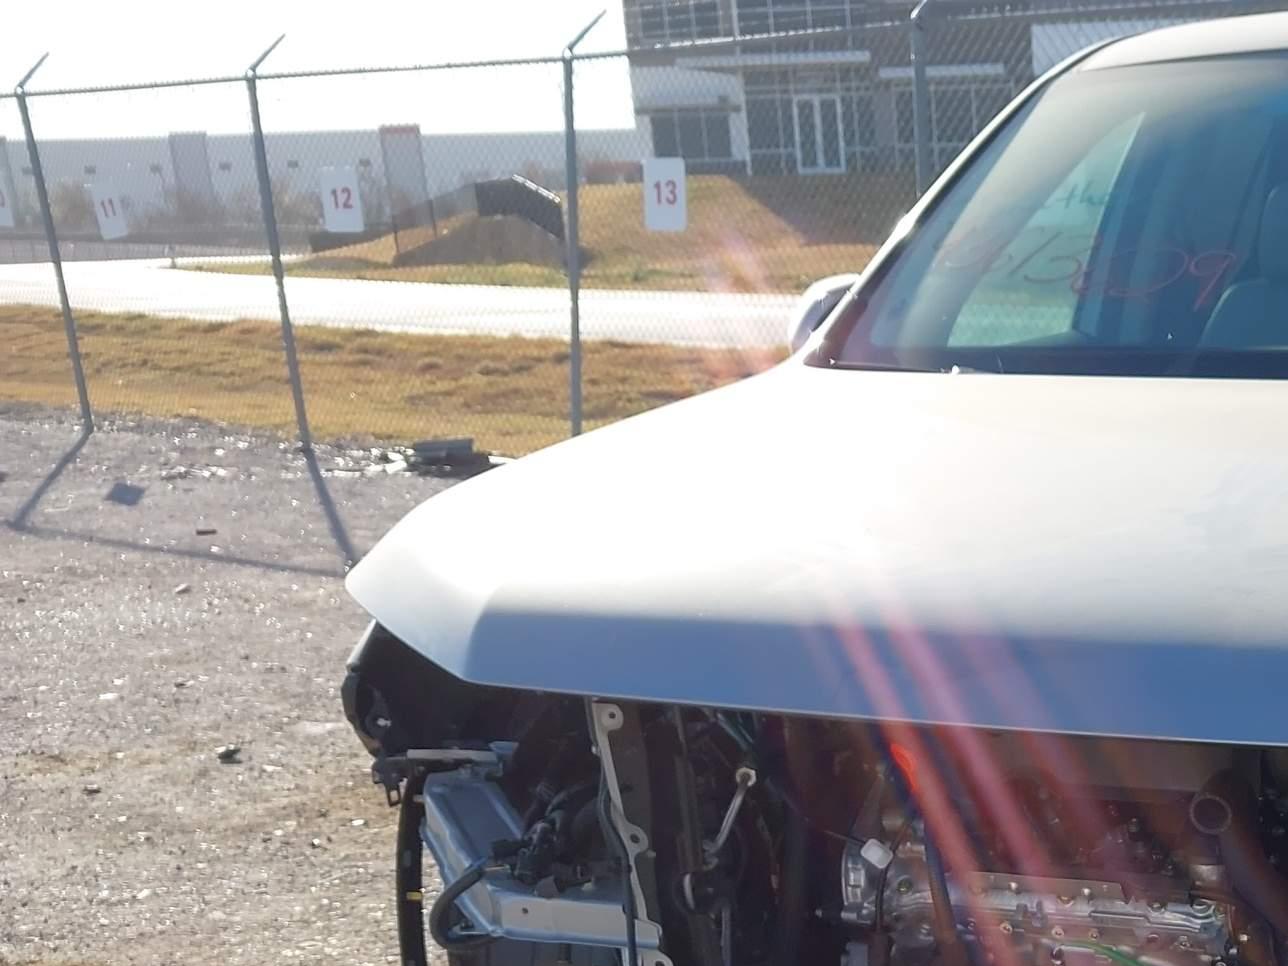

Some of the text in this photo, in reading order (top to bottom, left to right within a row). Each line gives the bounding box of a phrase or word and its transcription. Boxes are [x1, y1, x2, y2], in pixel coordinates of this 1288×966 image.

[330, 186, 354, 210] 12
[654, 179, 678, 205] 13
[100, 197, 116, 218] 11
